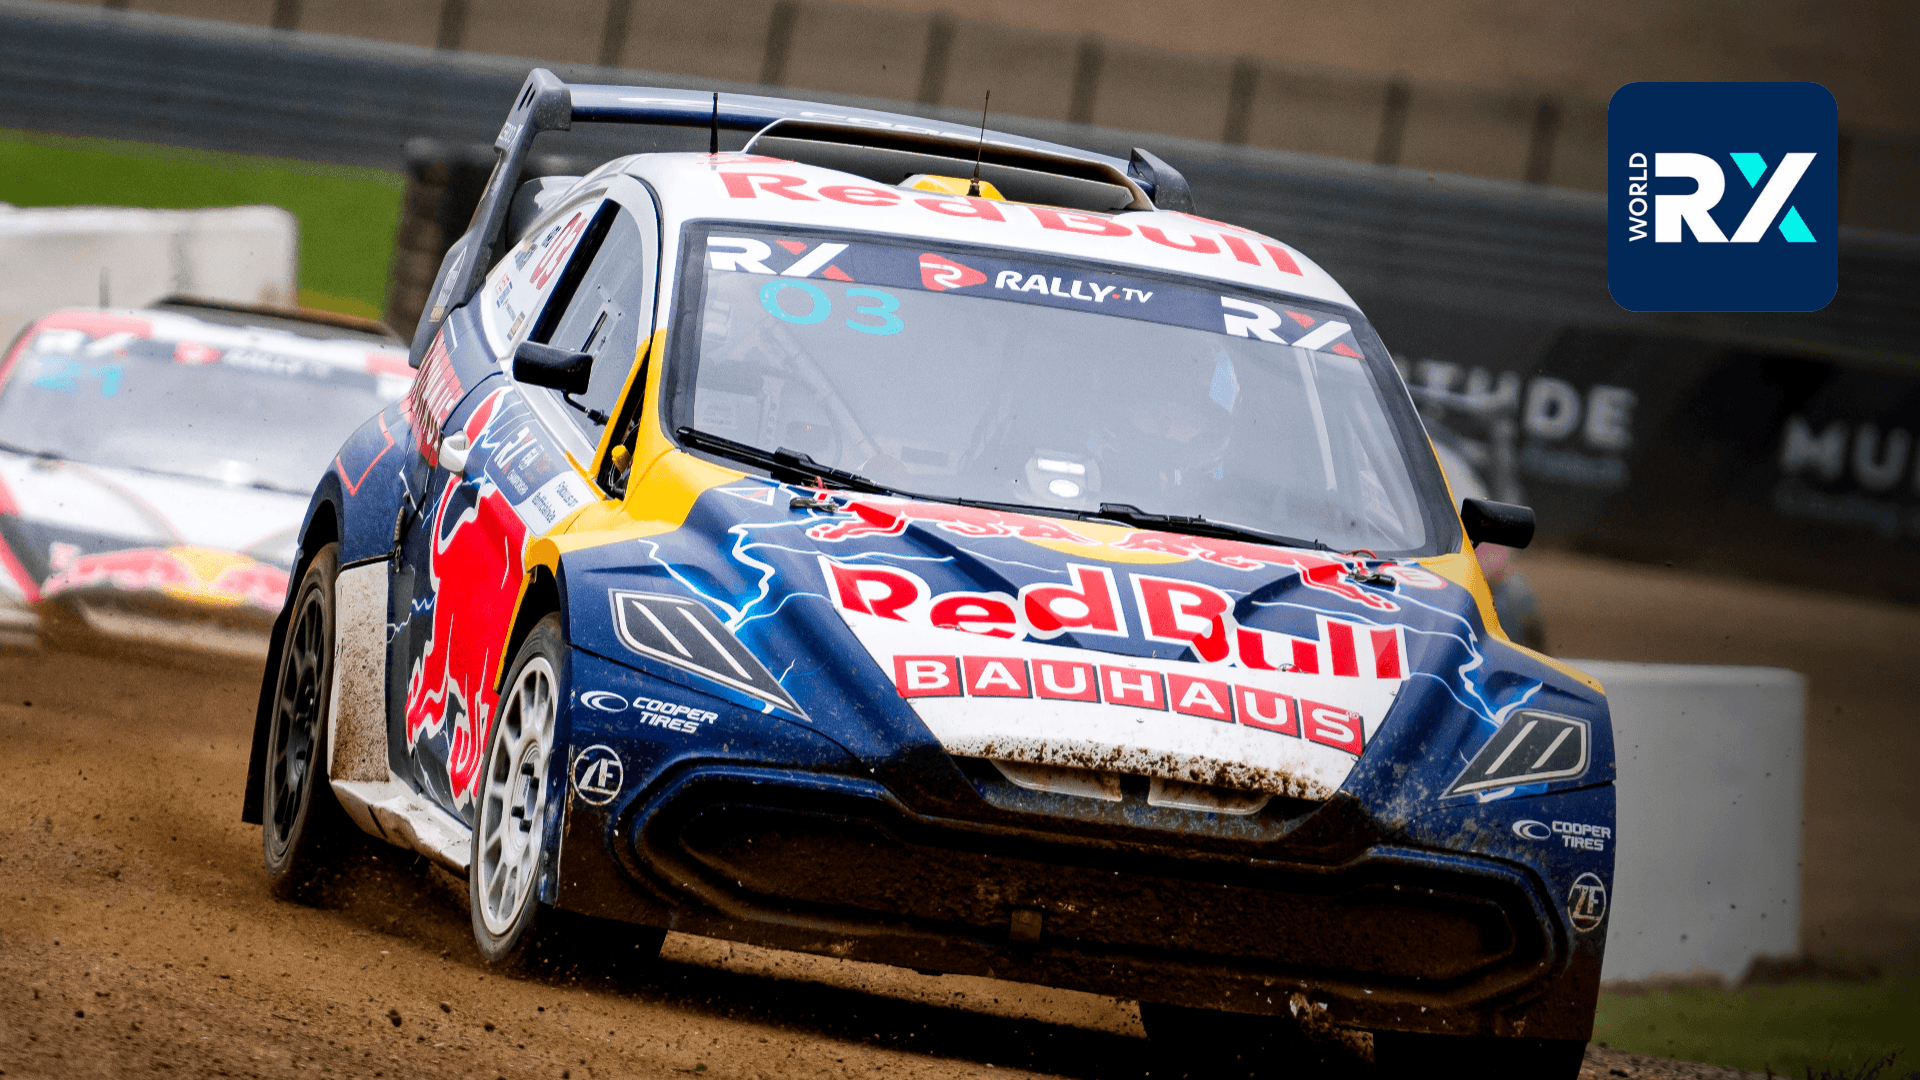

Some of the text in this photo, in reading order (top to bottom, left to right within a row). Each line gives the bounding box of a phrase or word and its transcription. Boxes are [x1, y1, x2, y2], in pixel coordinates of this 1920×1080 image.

[718, 171, 1303, 277] Red Bull
[707, 235, 855, 283] RX
[759, 277, 905, 336] 03
[1220, 295, 1365, 360] RX
[1779, 415, 1920, 488] MU
[828, 562, 1405, 678] Red Bull
[633, 696, 719, 724] COOPER
[640, 712, 699, 734] TIRES
[903, 657, 1357, 746] BAUHAUS
[576, 752, 622, 798] ZF
[1552, 820, 1611, 840] COOPER
[1562, 835, 1604, 852] TIRES
[1571, 883, 1606, 922] ZF
